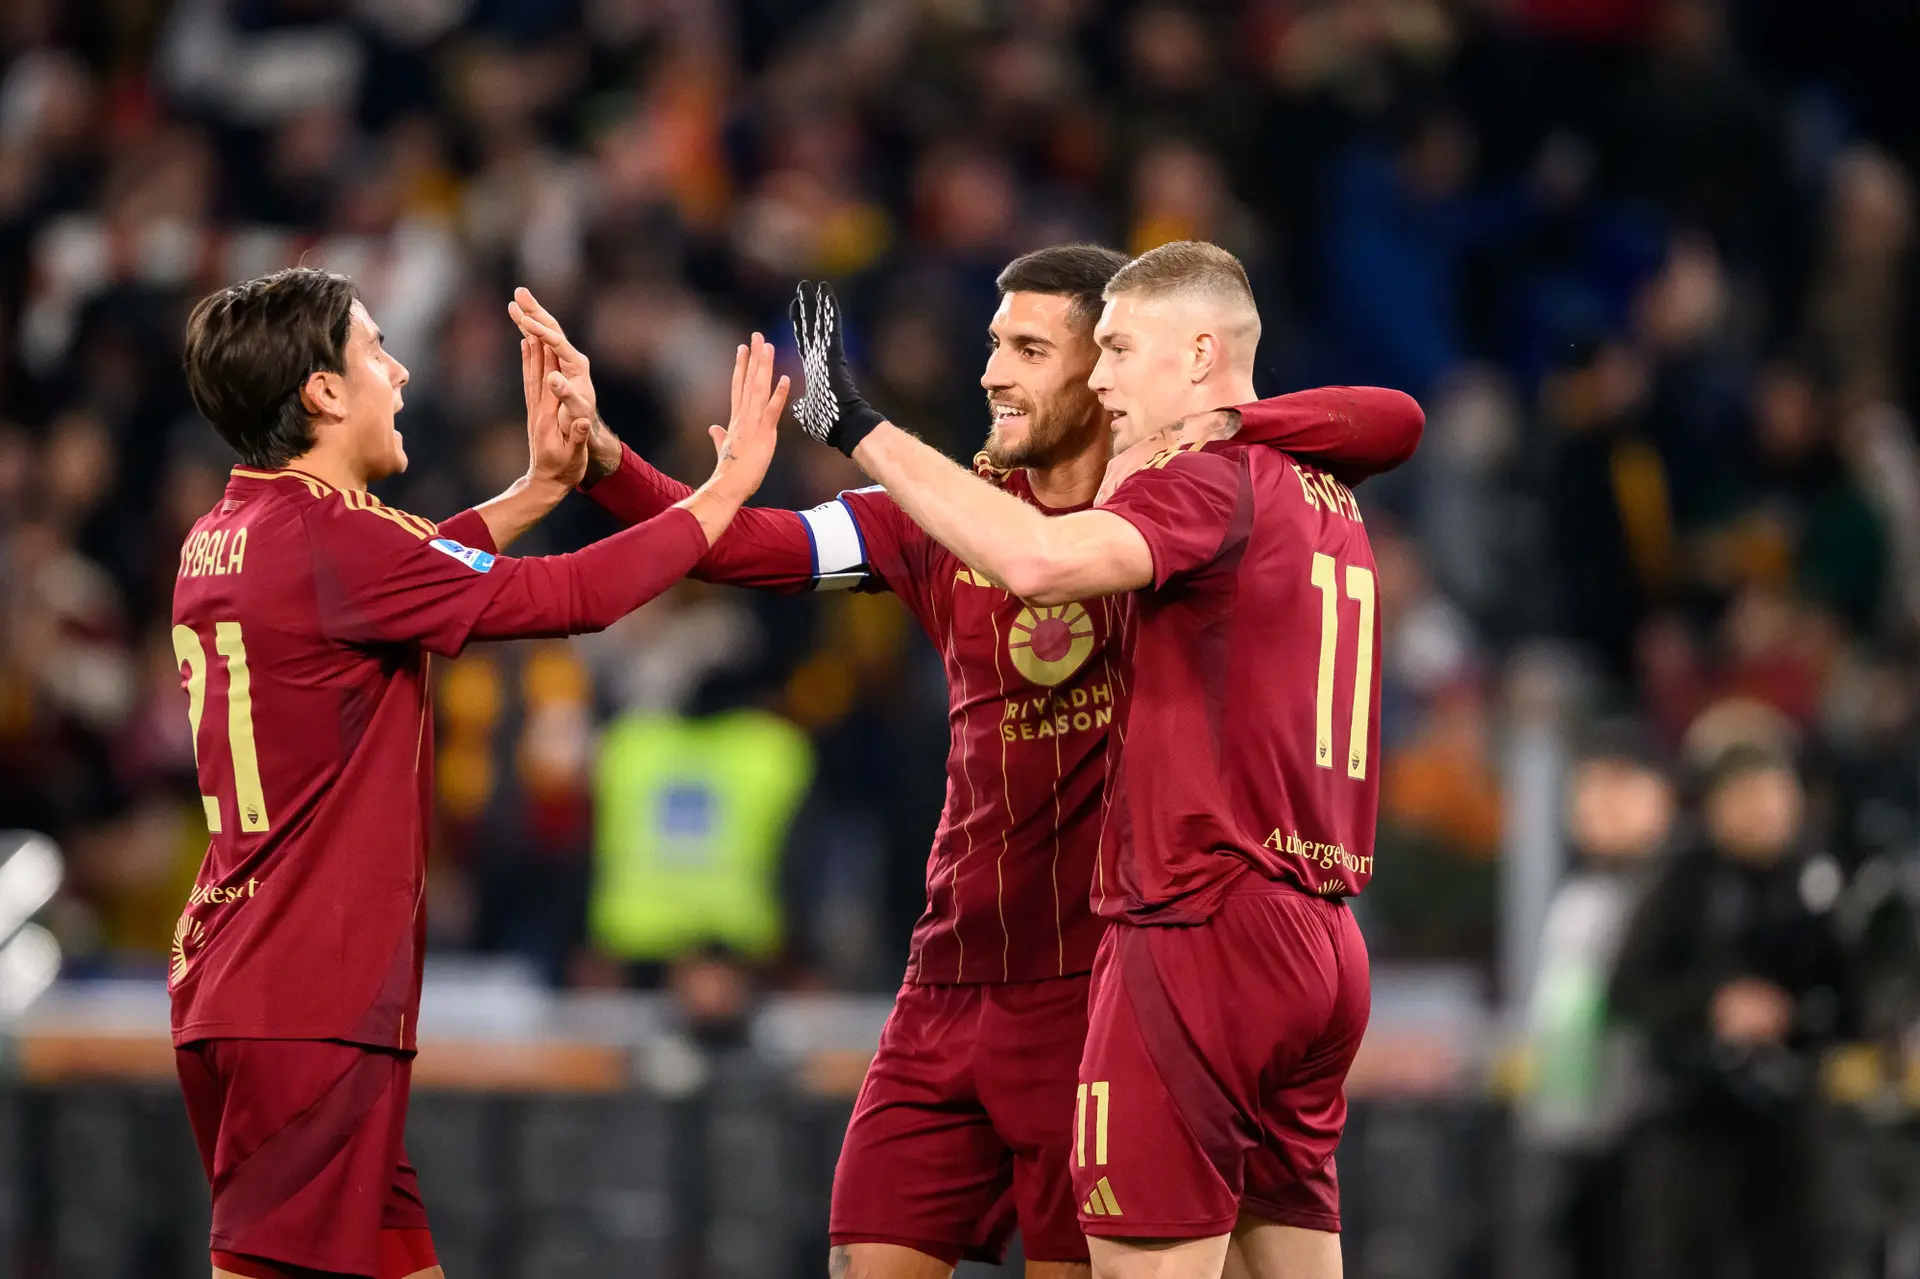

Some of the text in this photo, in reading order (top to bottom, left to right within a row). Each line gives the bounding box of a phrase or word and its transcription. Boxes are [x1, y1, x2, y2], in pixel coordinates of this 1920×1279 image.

[1006, 684, 1110, 719] RIYADH
[1311, 552, 1375, 780] 11
[172, 621, 270, 834] 21
[1003, 707, 1112, 742] SEASON
[1076, 1081, 1109, 1167] 11
